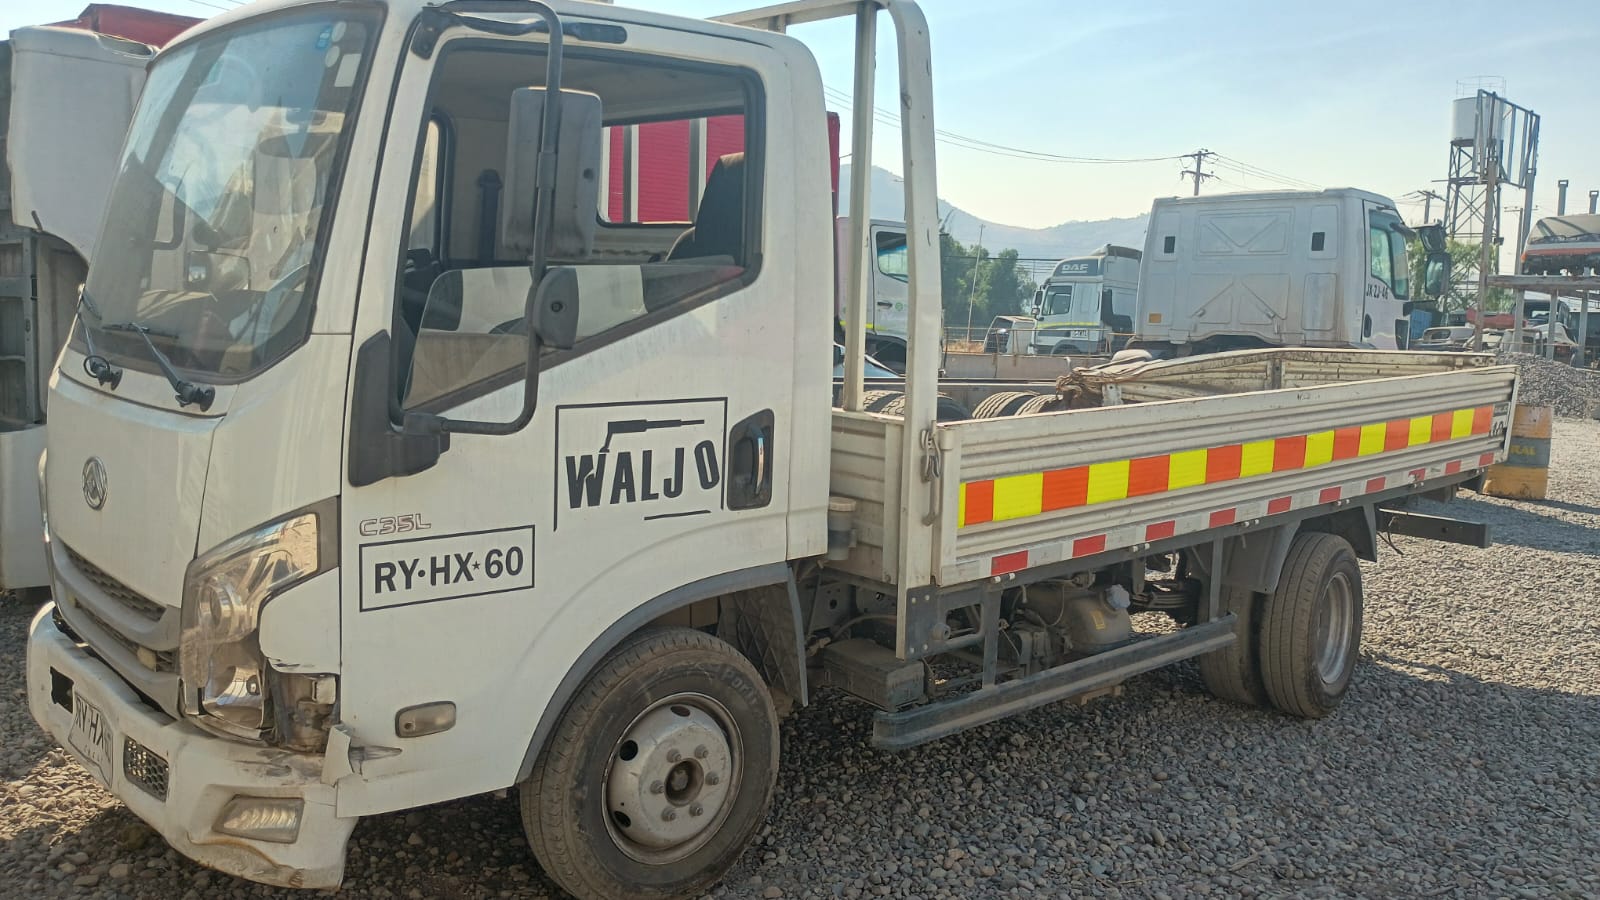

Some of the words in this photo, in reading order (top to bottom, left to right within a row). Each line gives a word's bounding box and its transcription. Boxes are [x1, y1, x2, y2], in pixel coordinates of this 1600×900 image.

[1061, 263, 1089, 271] DAF
[565, 439, 721, 509] WALJO
[359, 513, 432, 537] C35L
